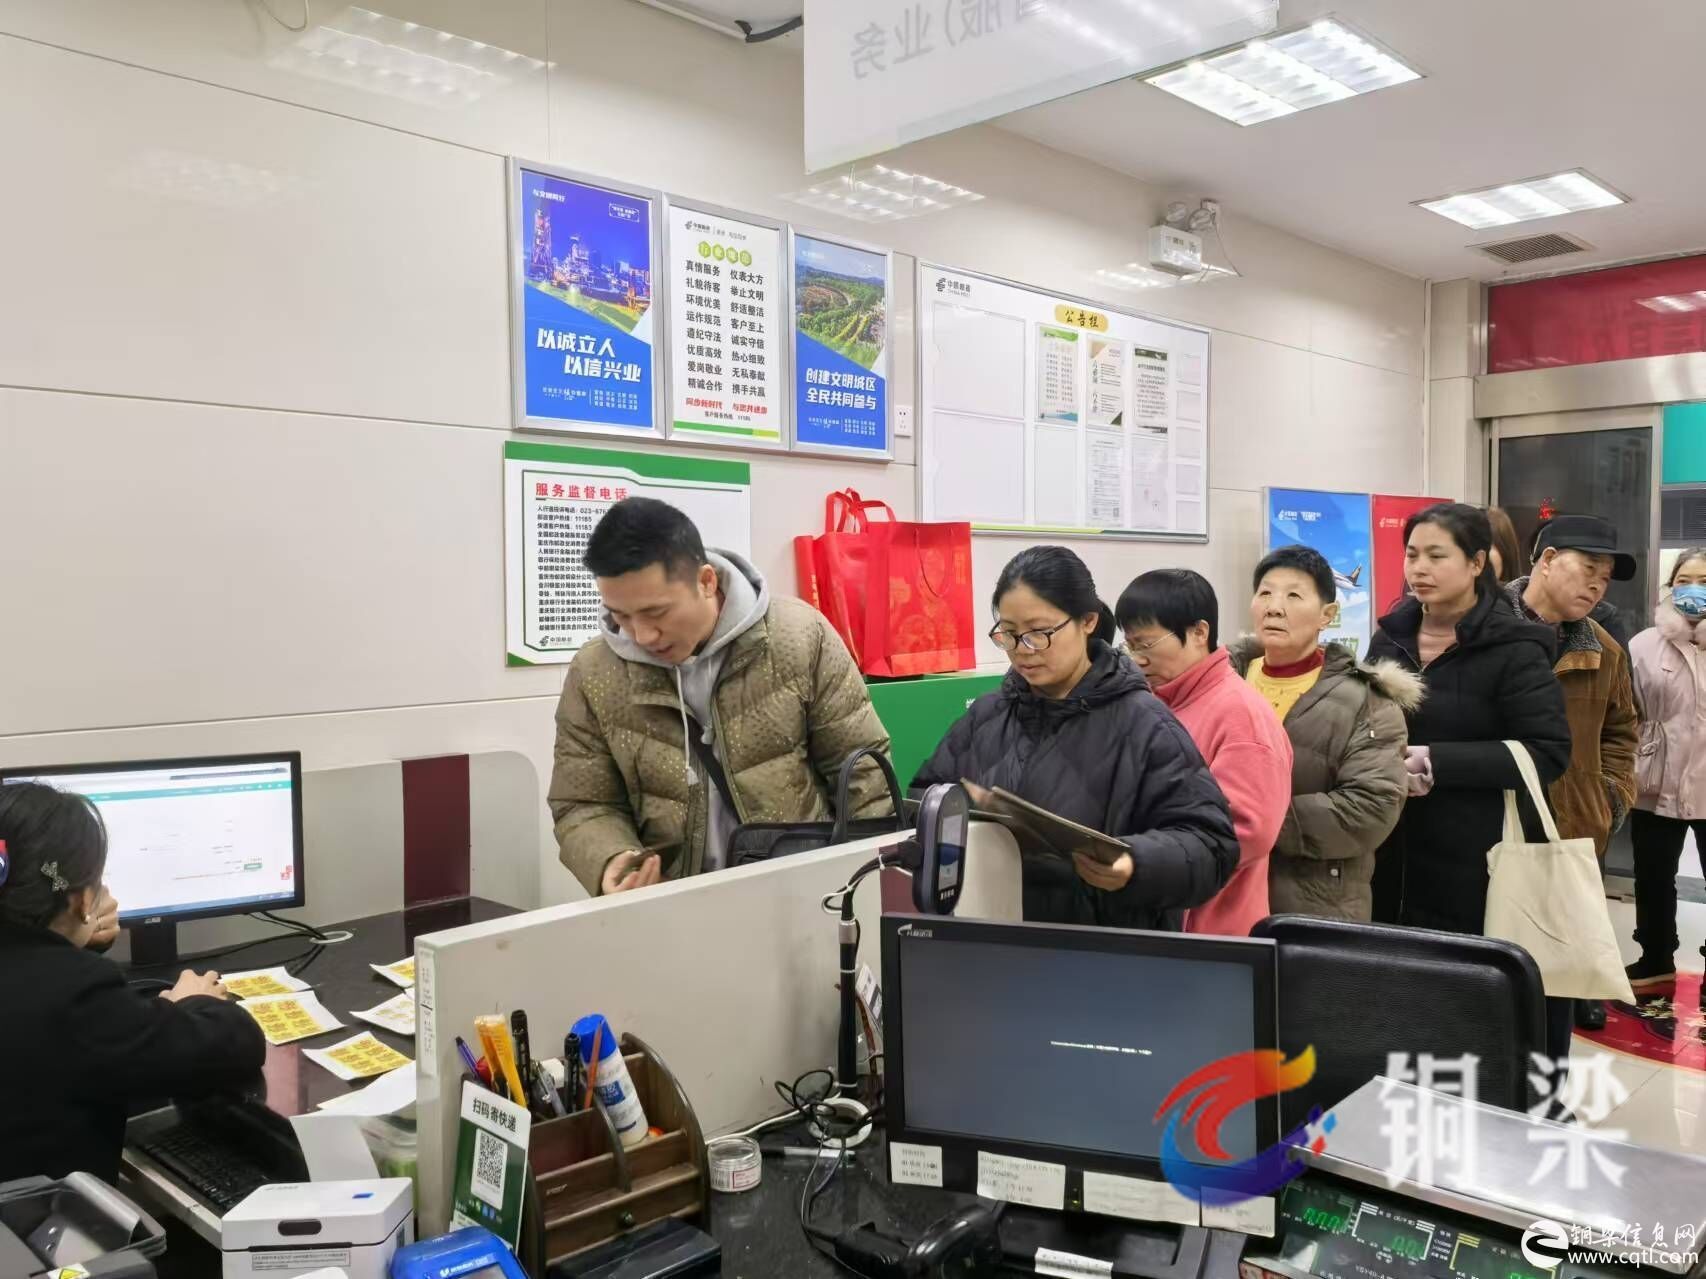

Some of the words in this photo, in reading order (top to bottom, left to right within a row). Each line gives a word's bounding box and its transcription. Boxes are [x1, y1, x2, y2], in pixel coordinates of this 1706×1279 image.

[686, 260, 720, 276] 真情服务
[730, 269, 764, 285] 仪表大方
[686, 277, 720, 293] 礼貌待客
[730, 285, 764, 301] 举止文明
[686, 294, 720, 310] 环境优美
[730, 302, 764, 317] 舒适整洁
[686, 310, 721, 327] 运作规范
[731, 318, 765, 334] 客户至上
[537, 328, 616, 358] 以诚立人
[687, 327, 721, 343] 遵纪守法
[731, 334, 765, 350] 诚实守信
[687, 344, 722, 359] 优质高效
[732, 351, 765, 365] 热心细致
[564, 355, 641, 383] 以信兴业
[688, 360, 723, 376] 爱岗敬业
[732, 367, 766, 381] 无私奉献
[806, 367, 877, 391] 创建文明城区
[688, 377, 722, 392] 精诚合作
[732, 383, 766, 398] 携手共赢
[806, 387, 877, 410] 全民共同参与
[536, 482, 628, 501] 服务监督电话
[473, 1097, 517, 1133] 扫码寄快递
